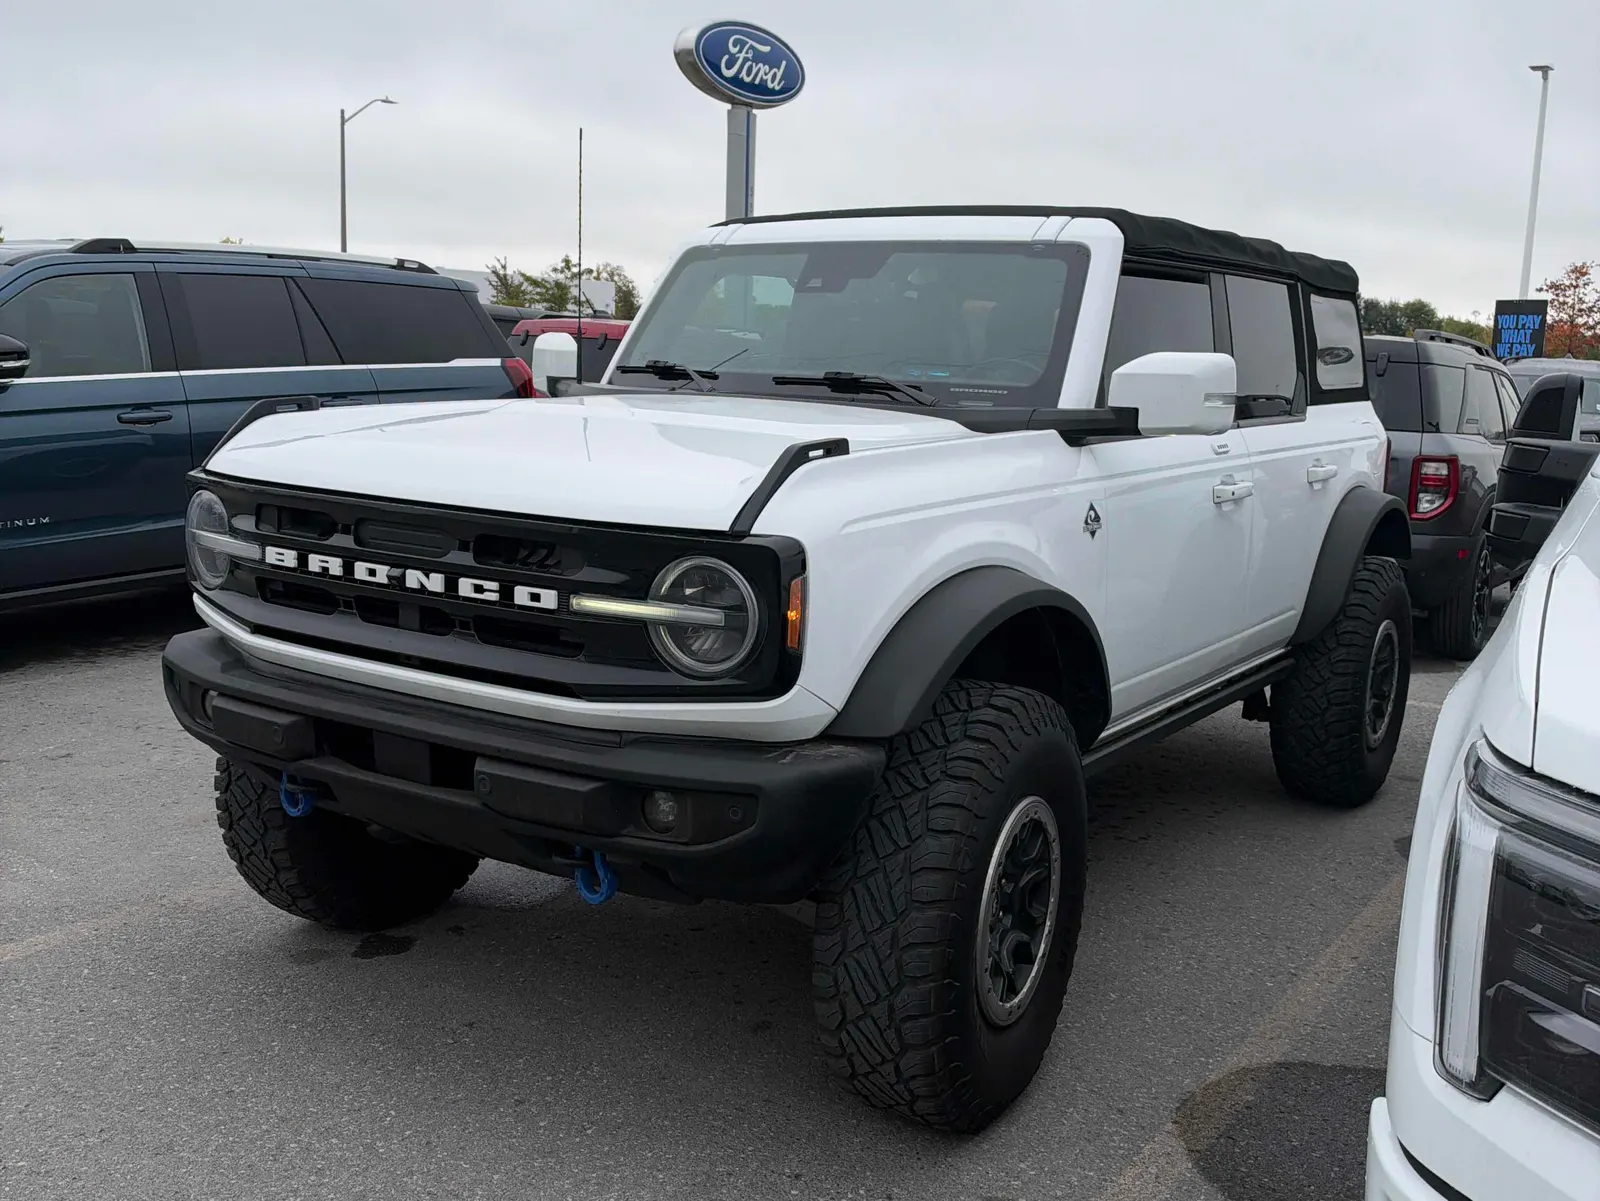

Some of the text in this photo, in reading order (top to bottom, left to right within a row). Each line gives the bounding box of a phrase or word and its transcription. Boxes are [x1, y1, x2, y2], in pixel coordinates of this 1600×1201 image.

[721, 34, 787, 91] Ford
[1497, 314, 1542, 329] YOU PAY
[1501, 329, 1533, 343] WHAT
[1496, 344, 1536, 358] WE PAY
[265, 546, 558, 610] BRONCO
